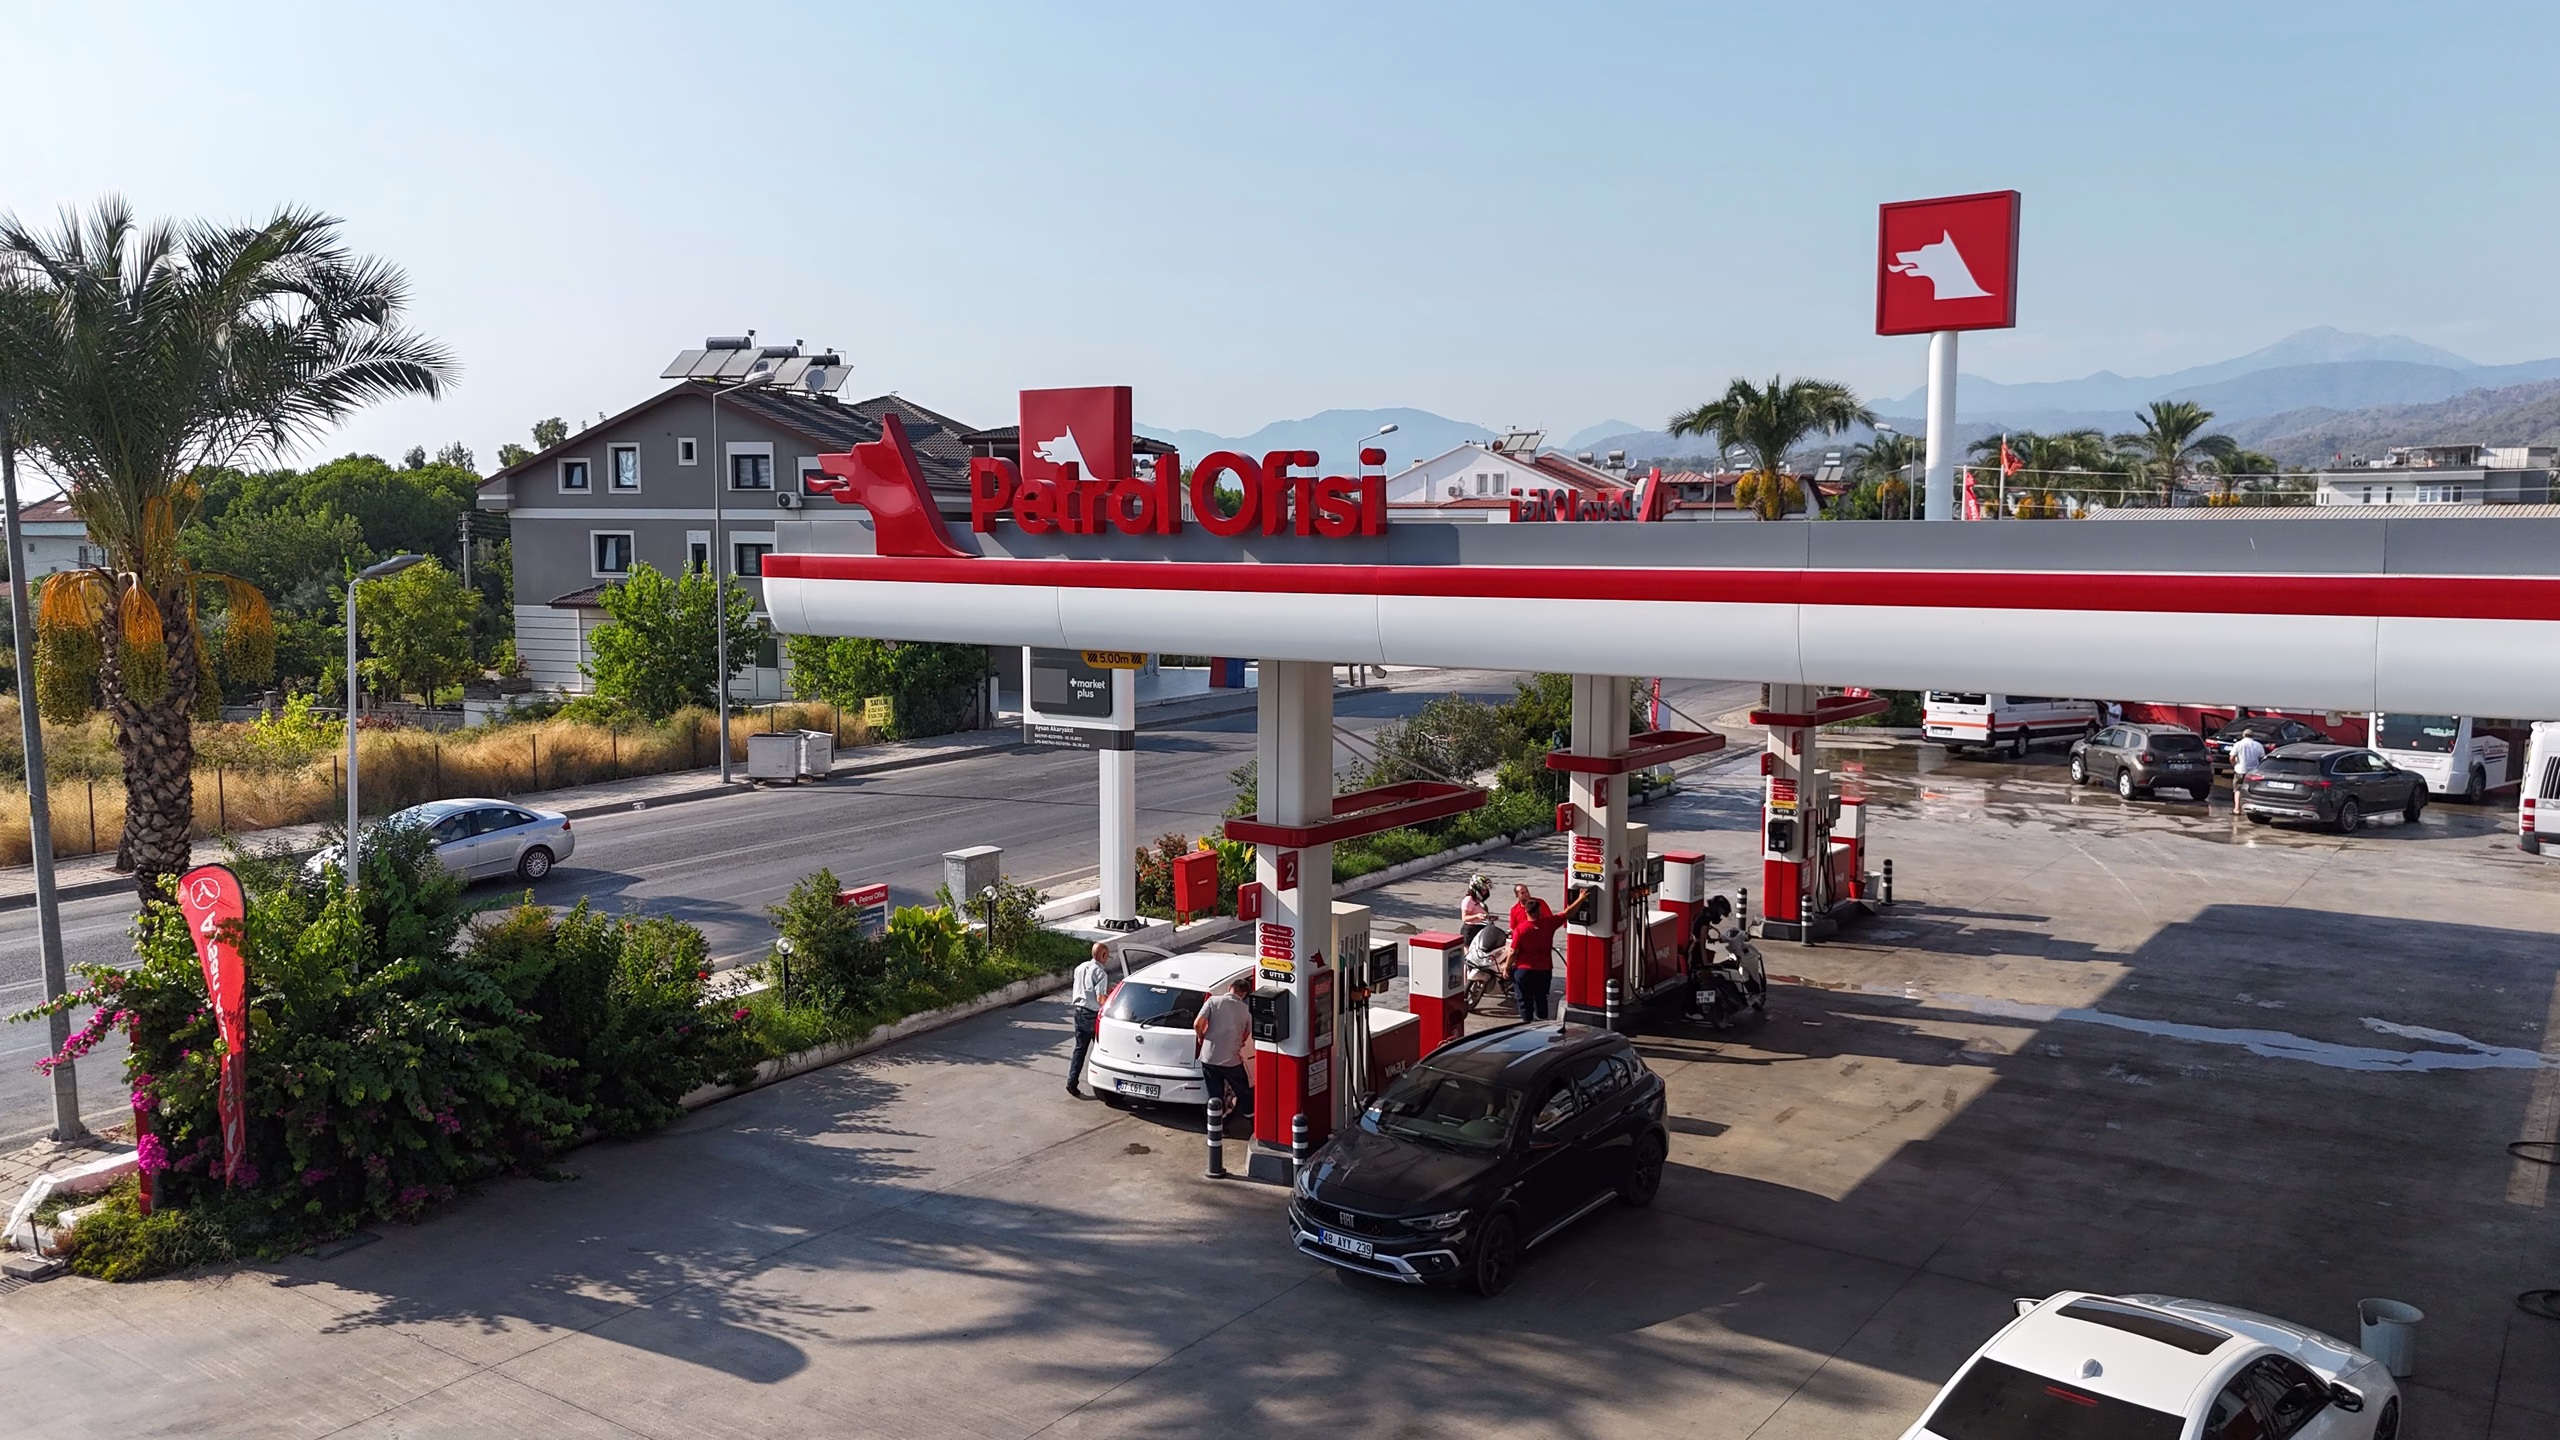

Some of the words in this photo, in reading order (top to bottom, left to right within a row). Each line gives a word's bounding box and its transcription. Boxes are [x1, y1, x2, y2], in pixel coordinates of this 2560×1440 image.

[970, 453, 1182, 535] Petrol
[1189, 448, 1388, 538] Ofisi
[1099, 652, 1130, 665] 5.00m
[1076, 688, 1095, 700] plus
[1600, 784, 1607, 800] 4
[1564, 809, 1572, 826] 3
[1286, 861, 1296, 883] 2
[858, 893, 874, 904] Petrol
[873, 889, 886, 900] Ofisi
[1250, 892, 1257, 913] 1
[1269, 970, 1286, 979] UTTS
[1145, 1085, 1158, 1096] 895
[1339, 1211, 1355, 1229] FIAT
[1323, 1232, 1333, 1244] 48
[1337, 1236, 1352, 1250] AYY
[1356, 1241, 1372, 1255] 239
